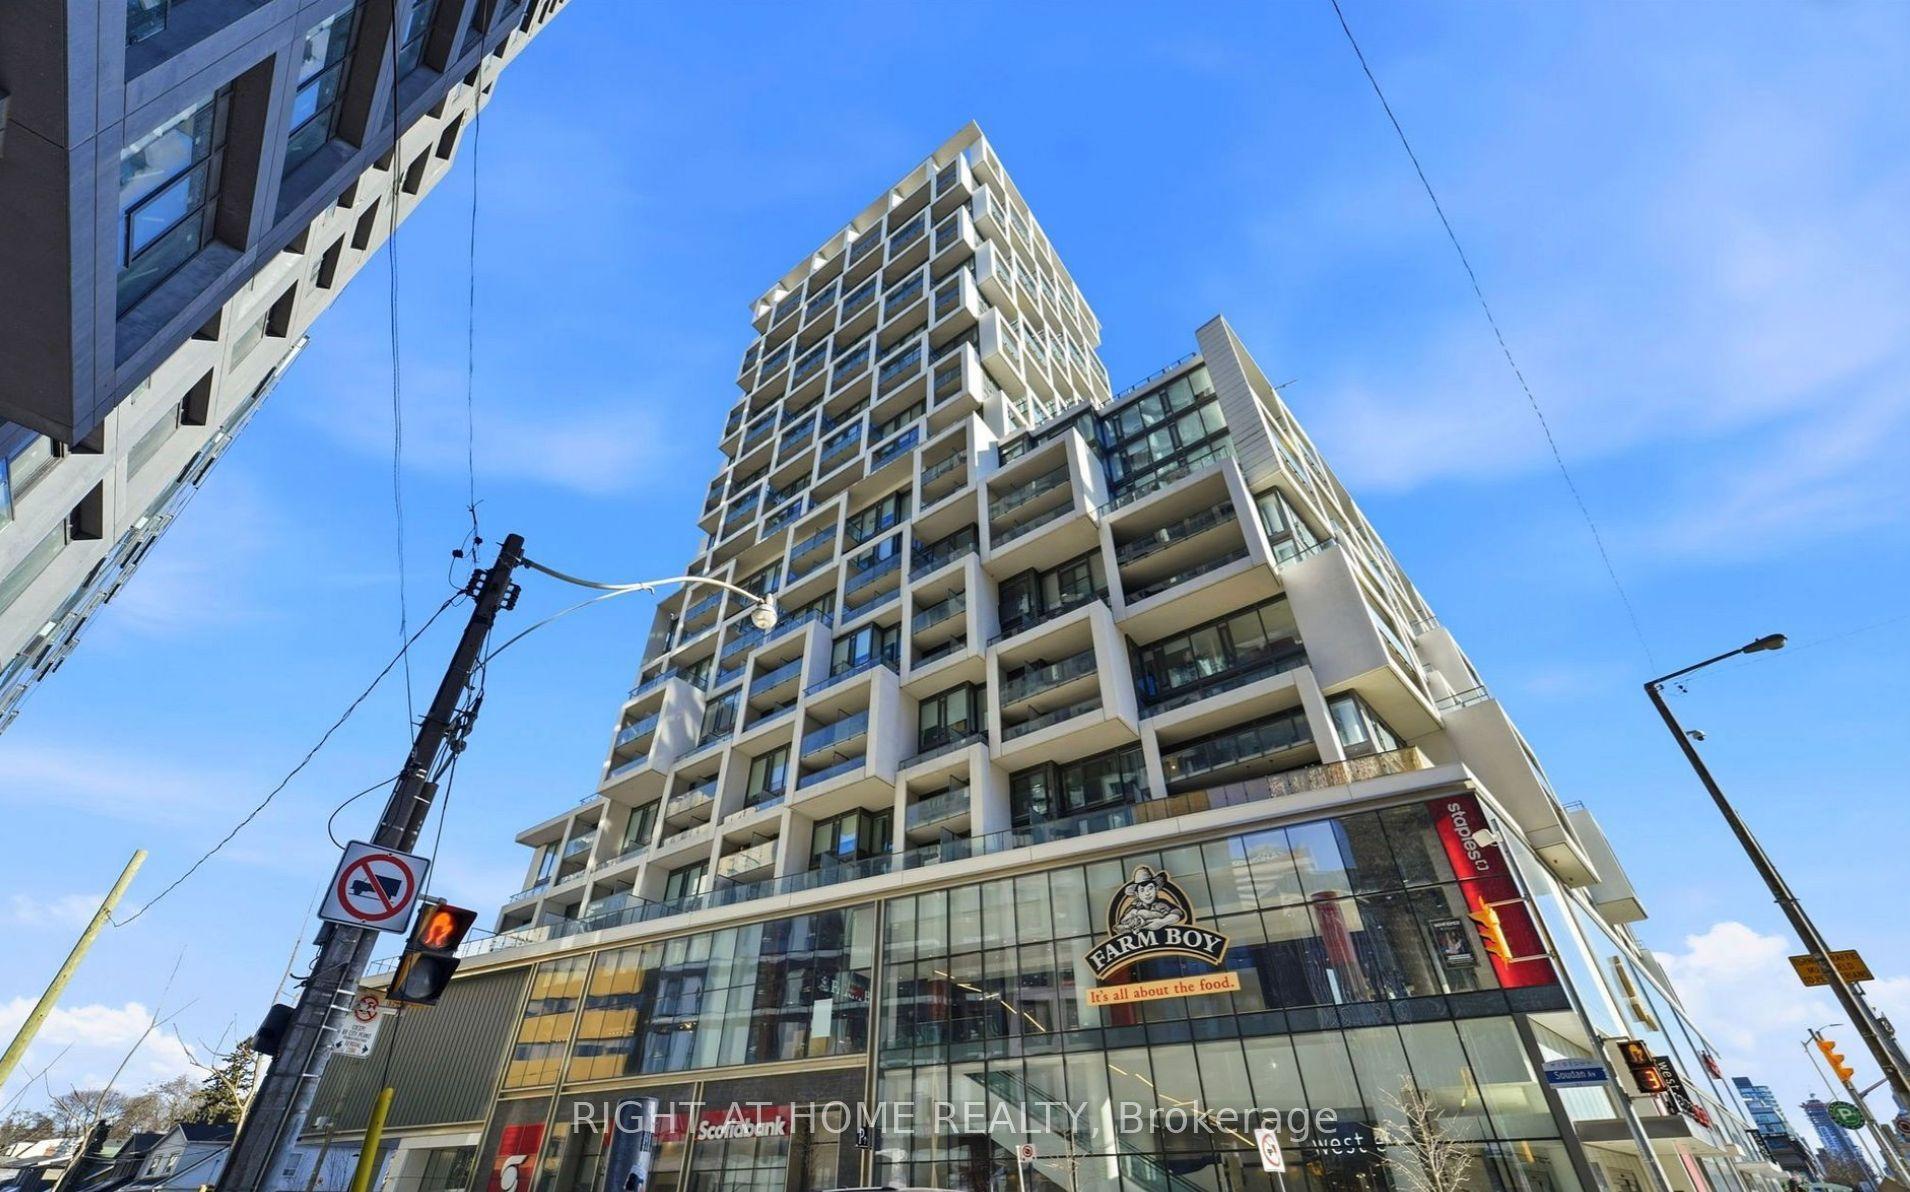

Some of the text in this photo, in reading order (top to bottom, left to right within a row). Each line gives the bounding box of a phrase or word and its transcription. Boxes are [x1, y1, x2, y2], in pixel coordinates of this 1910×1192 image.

[1447, 803, 1481, 860] staples
[1090, 928, 1221, 971] FARM BOY
[1090, 976, 1235, 1003] It's all about the food.
[698, 1115, 786, 1140] Scotiabank
[1312, 1132, 1368, 1155] west
